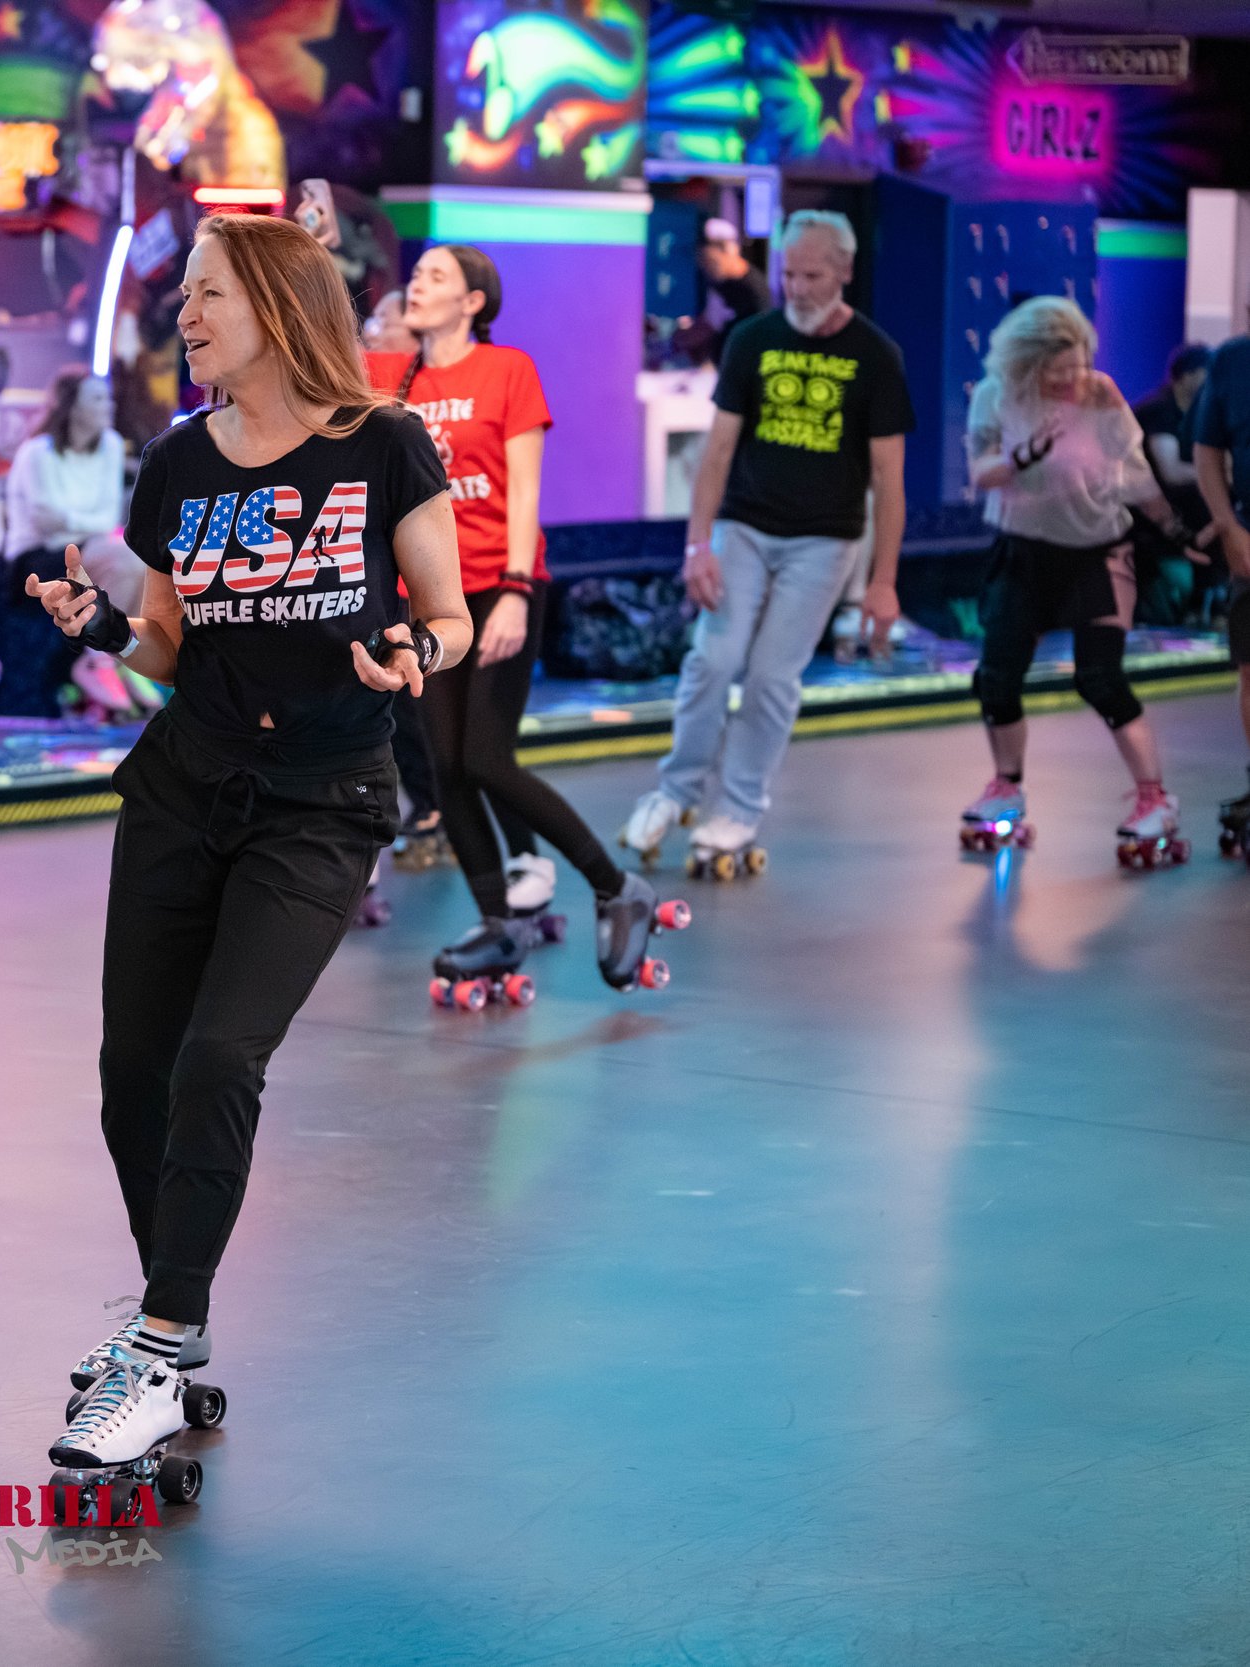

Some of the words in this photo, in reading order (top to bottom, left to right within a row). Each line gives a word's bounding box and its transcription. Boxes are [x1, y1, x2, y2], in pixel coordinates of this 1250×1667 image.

[1007, 102, 1100, 161] GIRLZ
[410, 398, 475, 424] STATE
[450, 473, 491, 501] ATS
[168, 481, 368, 596] USA
[177, 597, 255, 627] UFFLE
[260, 586, 367, 622] SKATERS
